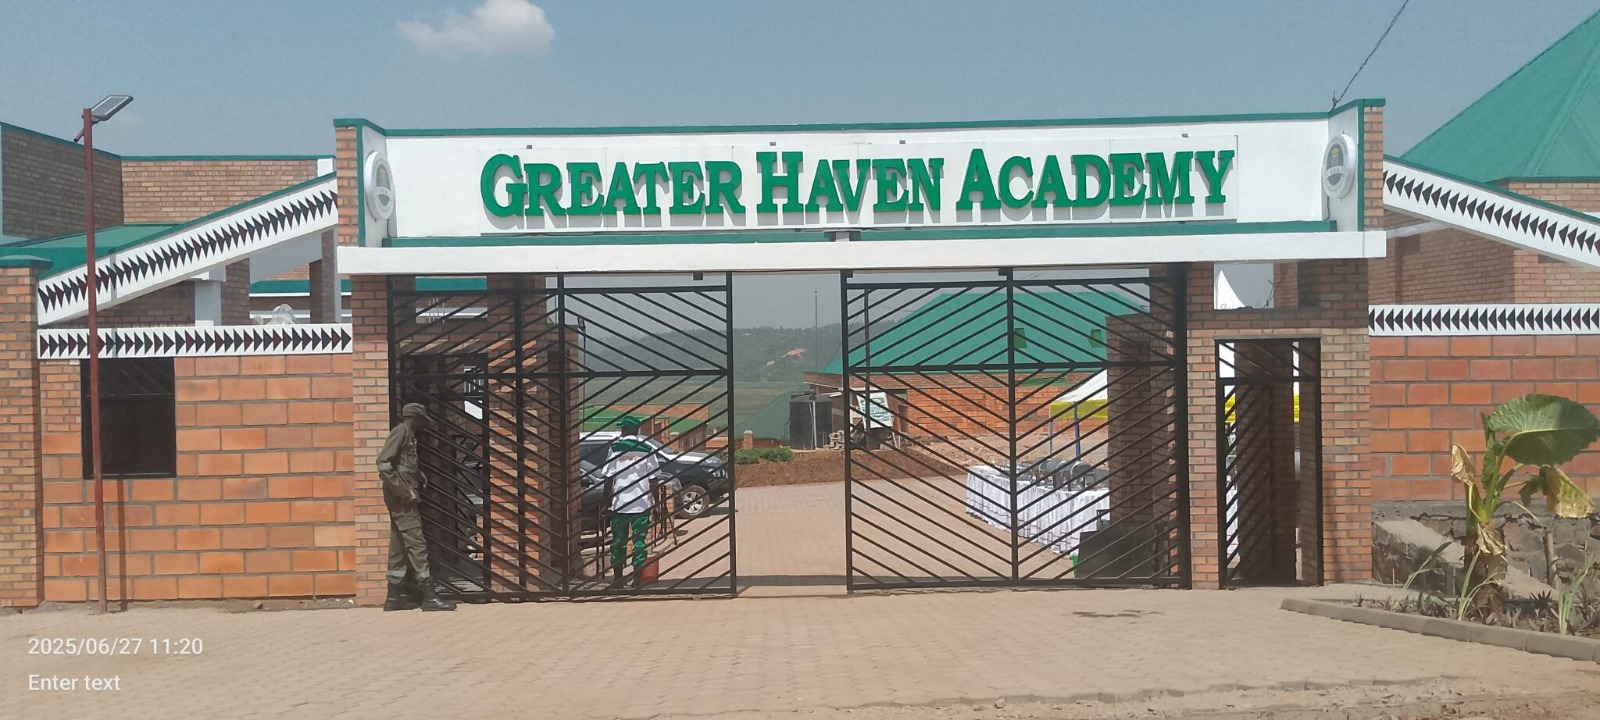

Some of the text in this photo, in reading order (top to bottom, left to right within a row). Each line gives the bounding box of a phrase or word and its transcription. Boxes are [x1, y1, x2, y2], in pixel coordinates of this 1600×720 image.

[480, 148, 1235, 217] GREATER HAVEN ACADEMY
